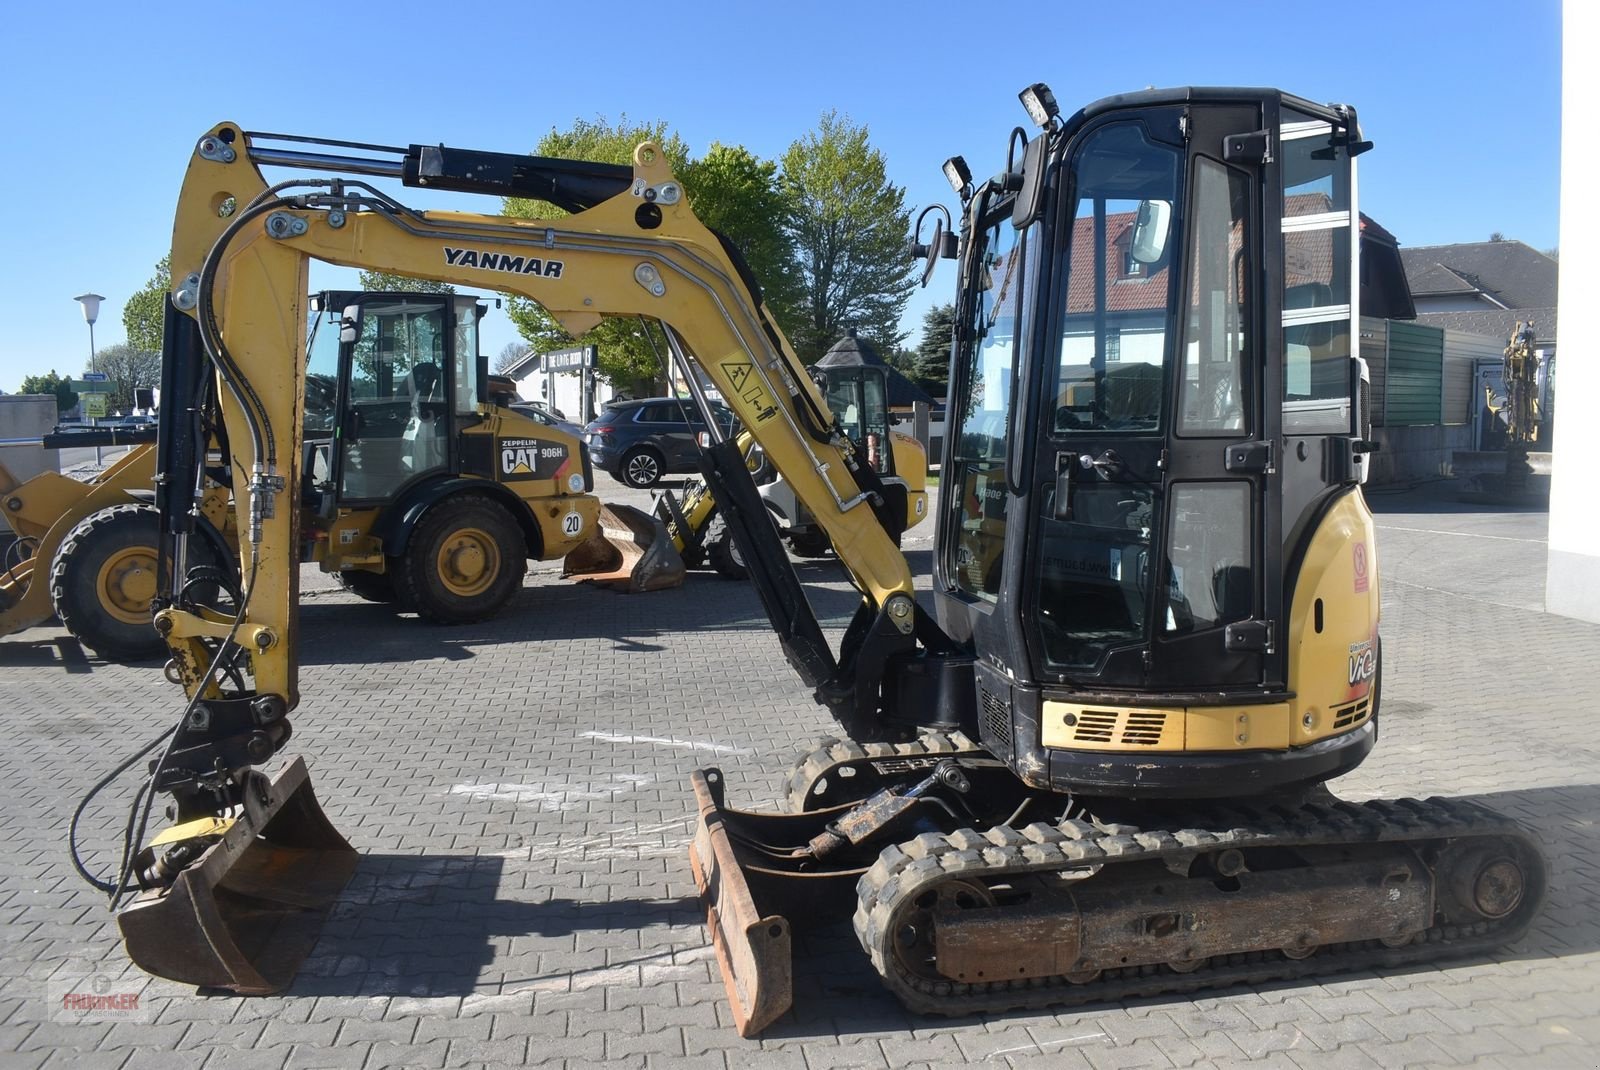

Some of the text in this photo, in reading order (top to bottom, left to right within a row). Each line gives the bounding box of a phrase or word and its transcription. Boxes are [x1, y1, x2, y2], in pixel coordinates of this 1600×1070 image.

[444, 248, 563, 278] YANMAR
[502, 449, 538, 474] CAT
[541, 447, 563, 458] 906H
[566, 516, 579, 533] 20
